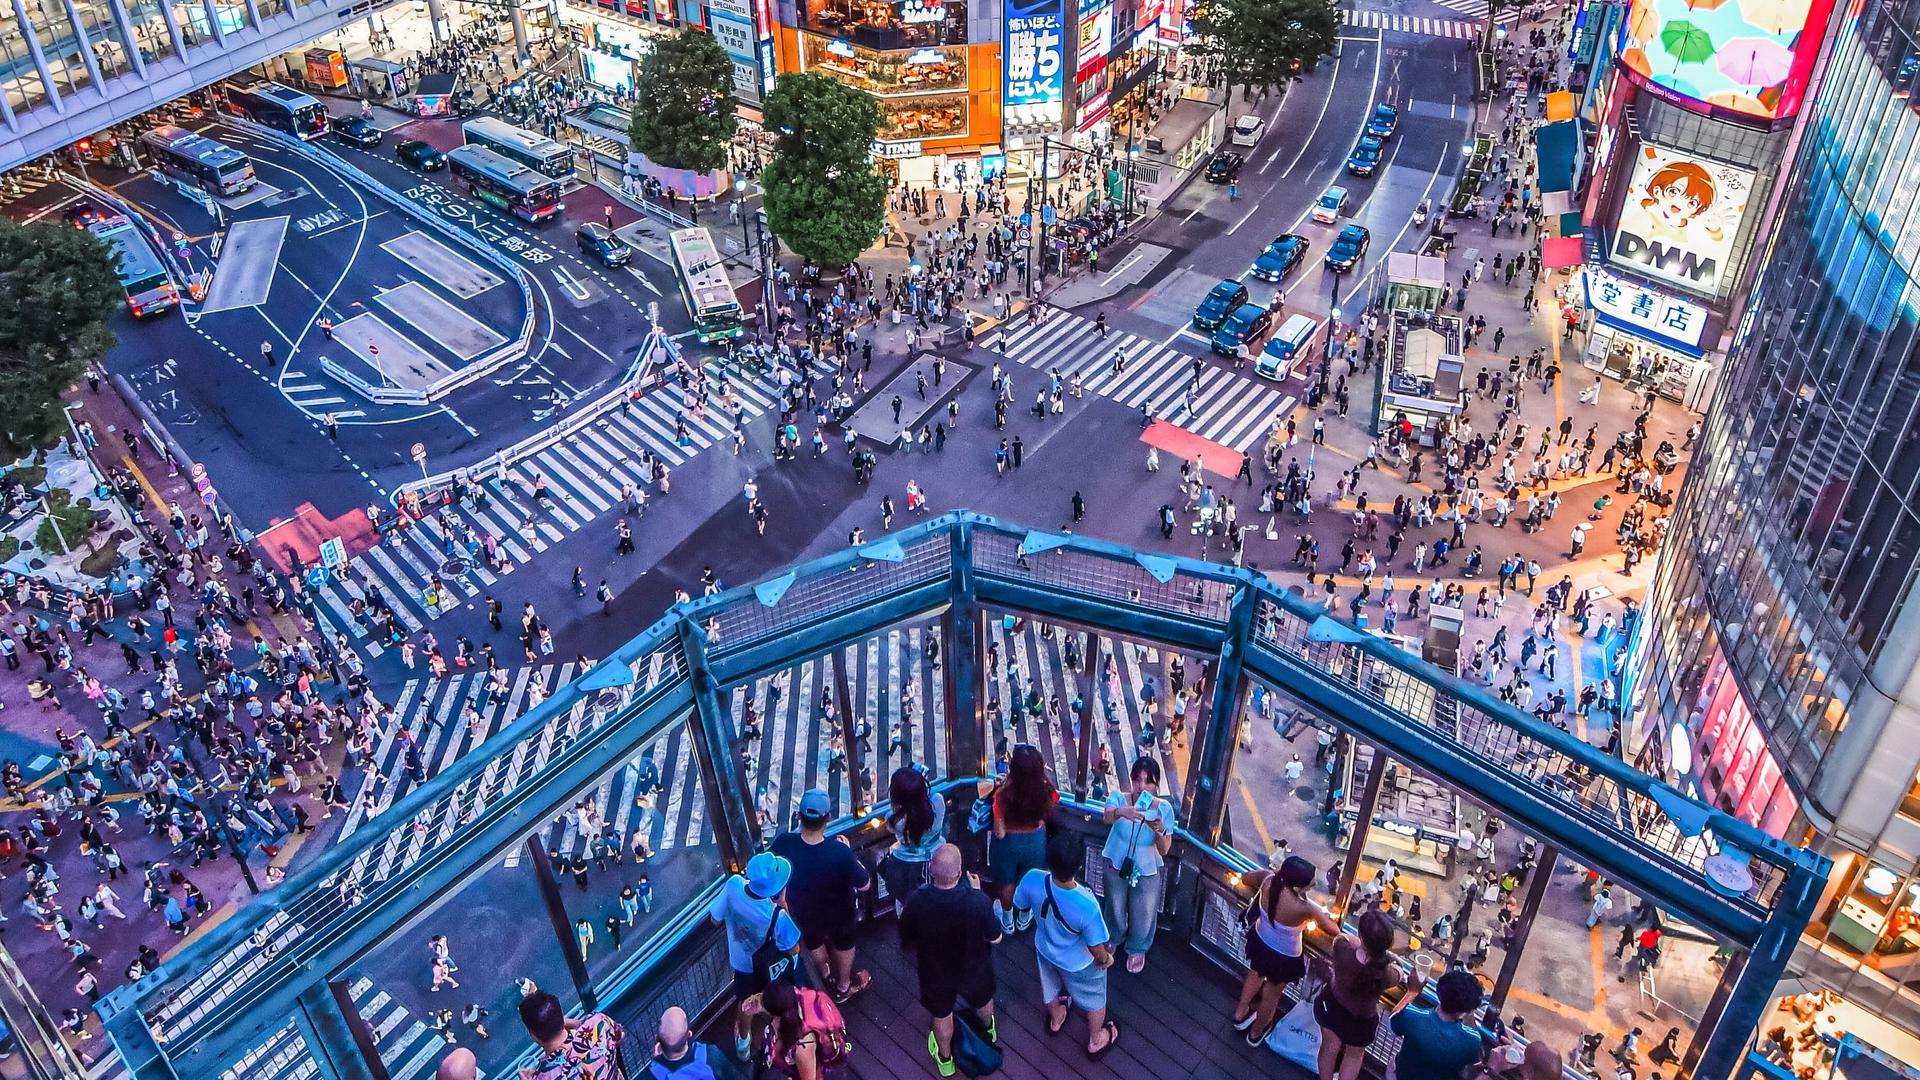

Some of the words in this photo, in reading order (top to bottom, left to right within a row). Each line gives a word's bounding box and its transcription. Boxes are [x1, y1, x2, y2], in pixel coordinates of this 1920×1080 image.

[714, 1, 746, 14] SPECIALISTS
[1008, 15, 1061, 32] 怖いほど、
[1008, 29, 1060, 81] 勝ち
[1008, 77, 1061, 98] にいく
[1615, 230, 1716, 288] DMM
[1592, 277, 1692, 332] 堂書店
